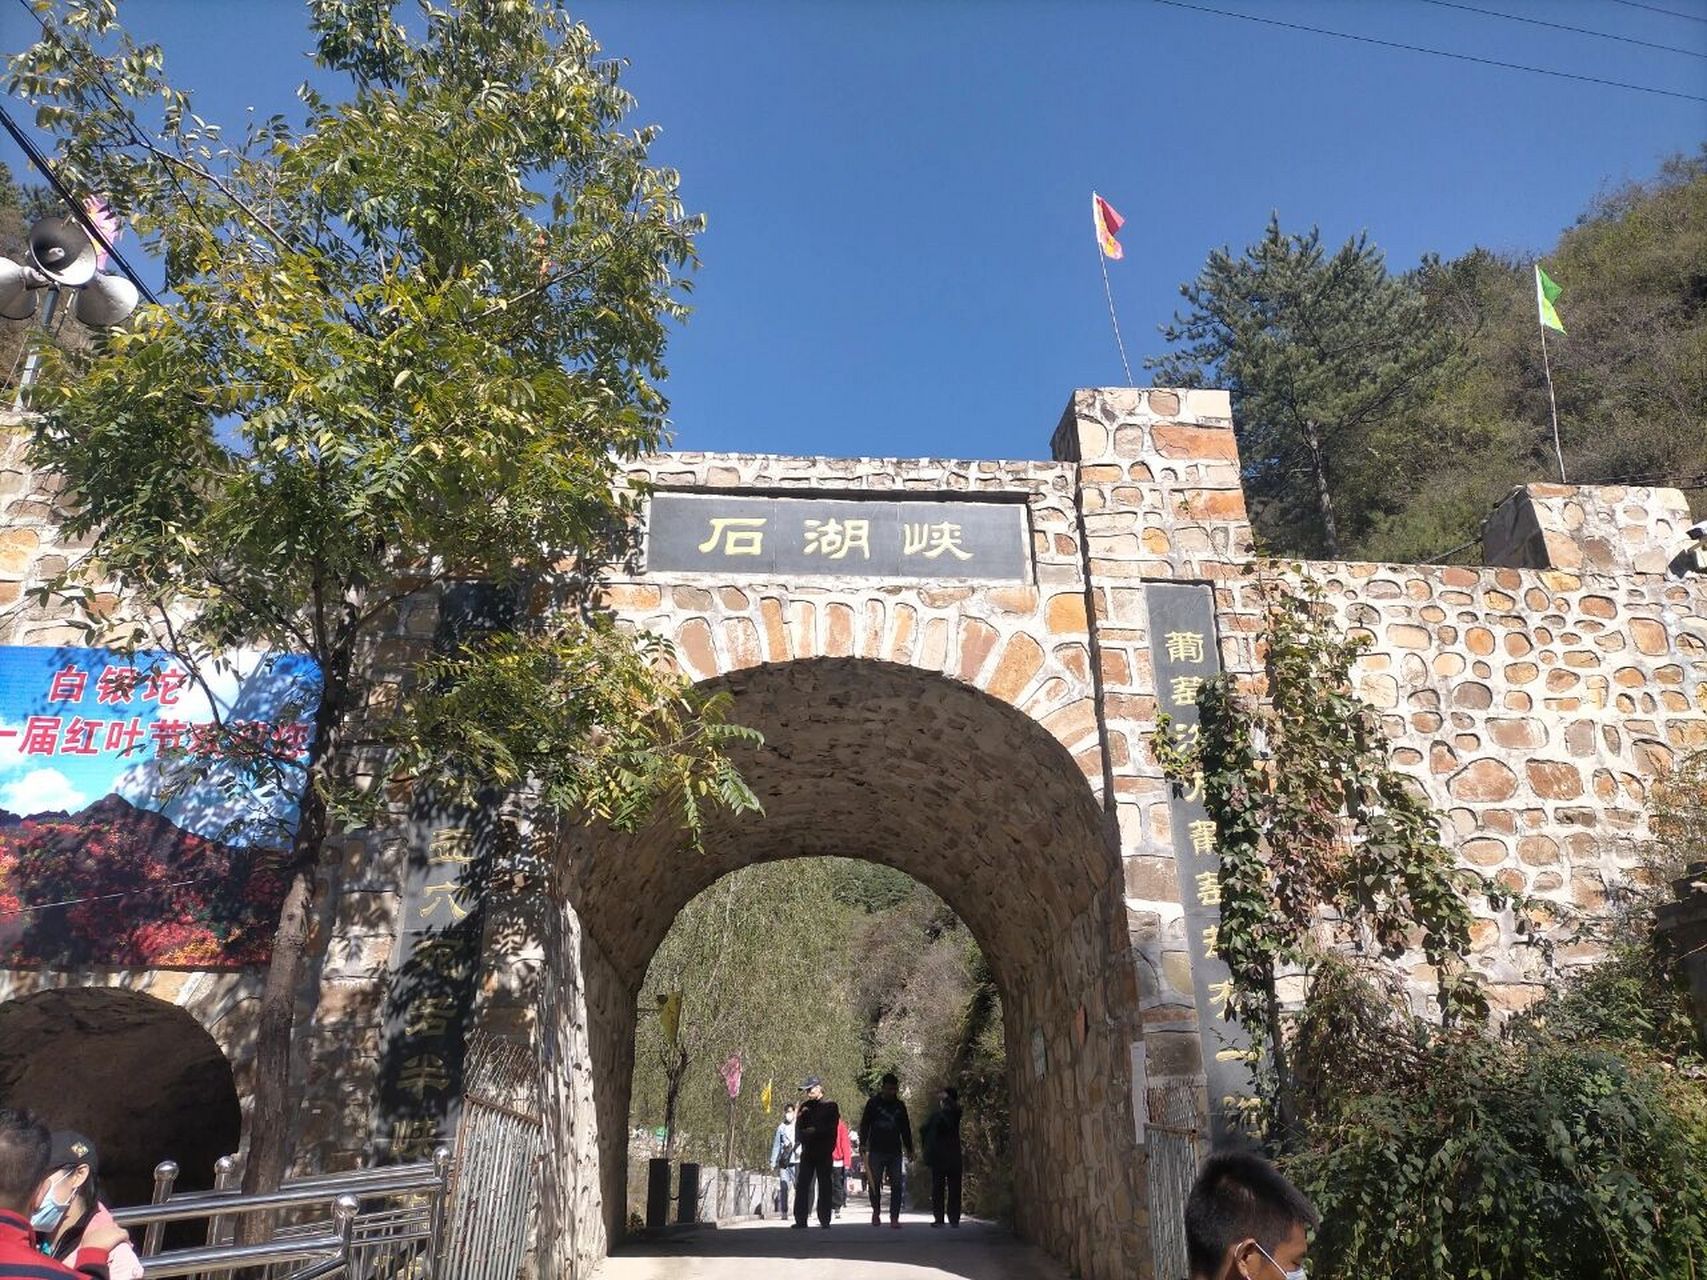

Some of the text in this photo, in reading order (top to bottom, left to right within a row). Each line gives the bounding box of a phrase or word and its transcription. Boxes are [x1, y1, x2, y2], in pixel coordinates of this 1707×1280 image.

[697, 517, 975, 561] 石湖峡
[48, 663, 187, 706] 白银坨
